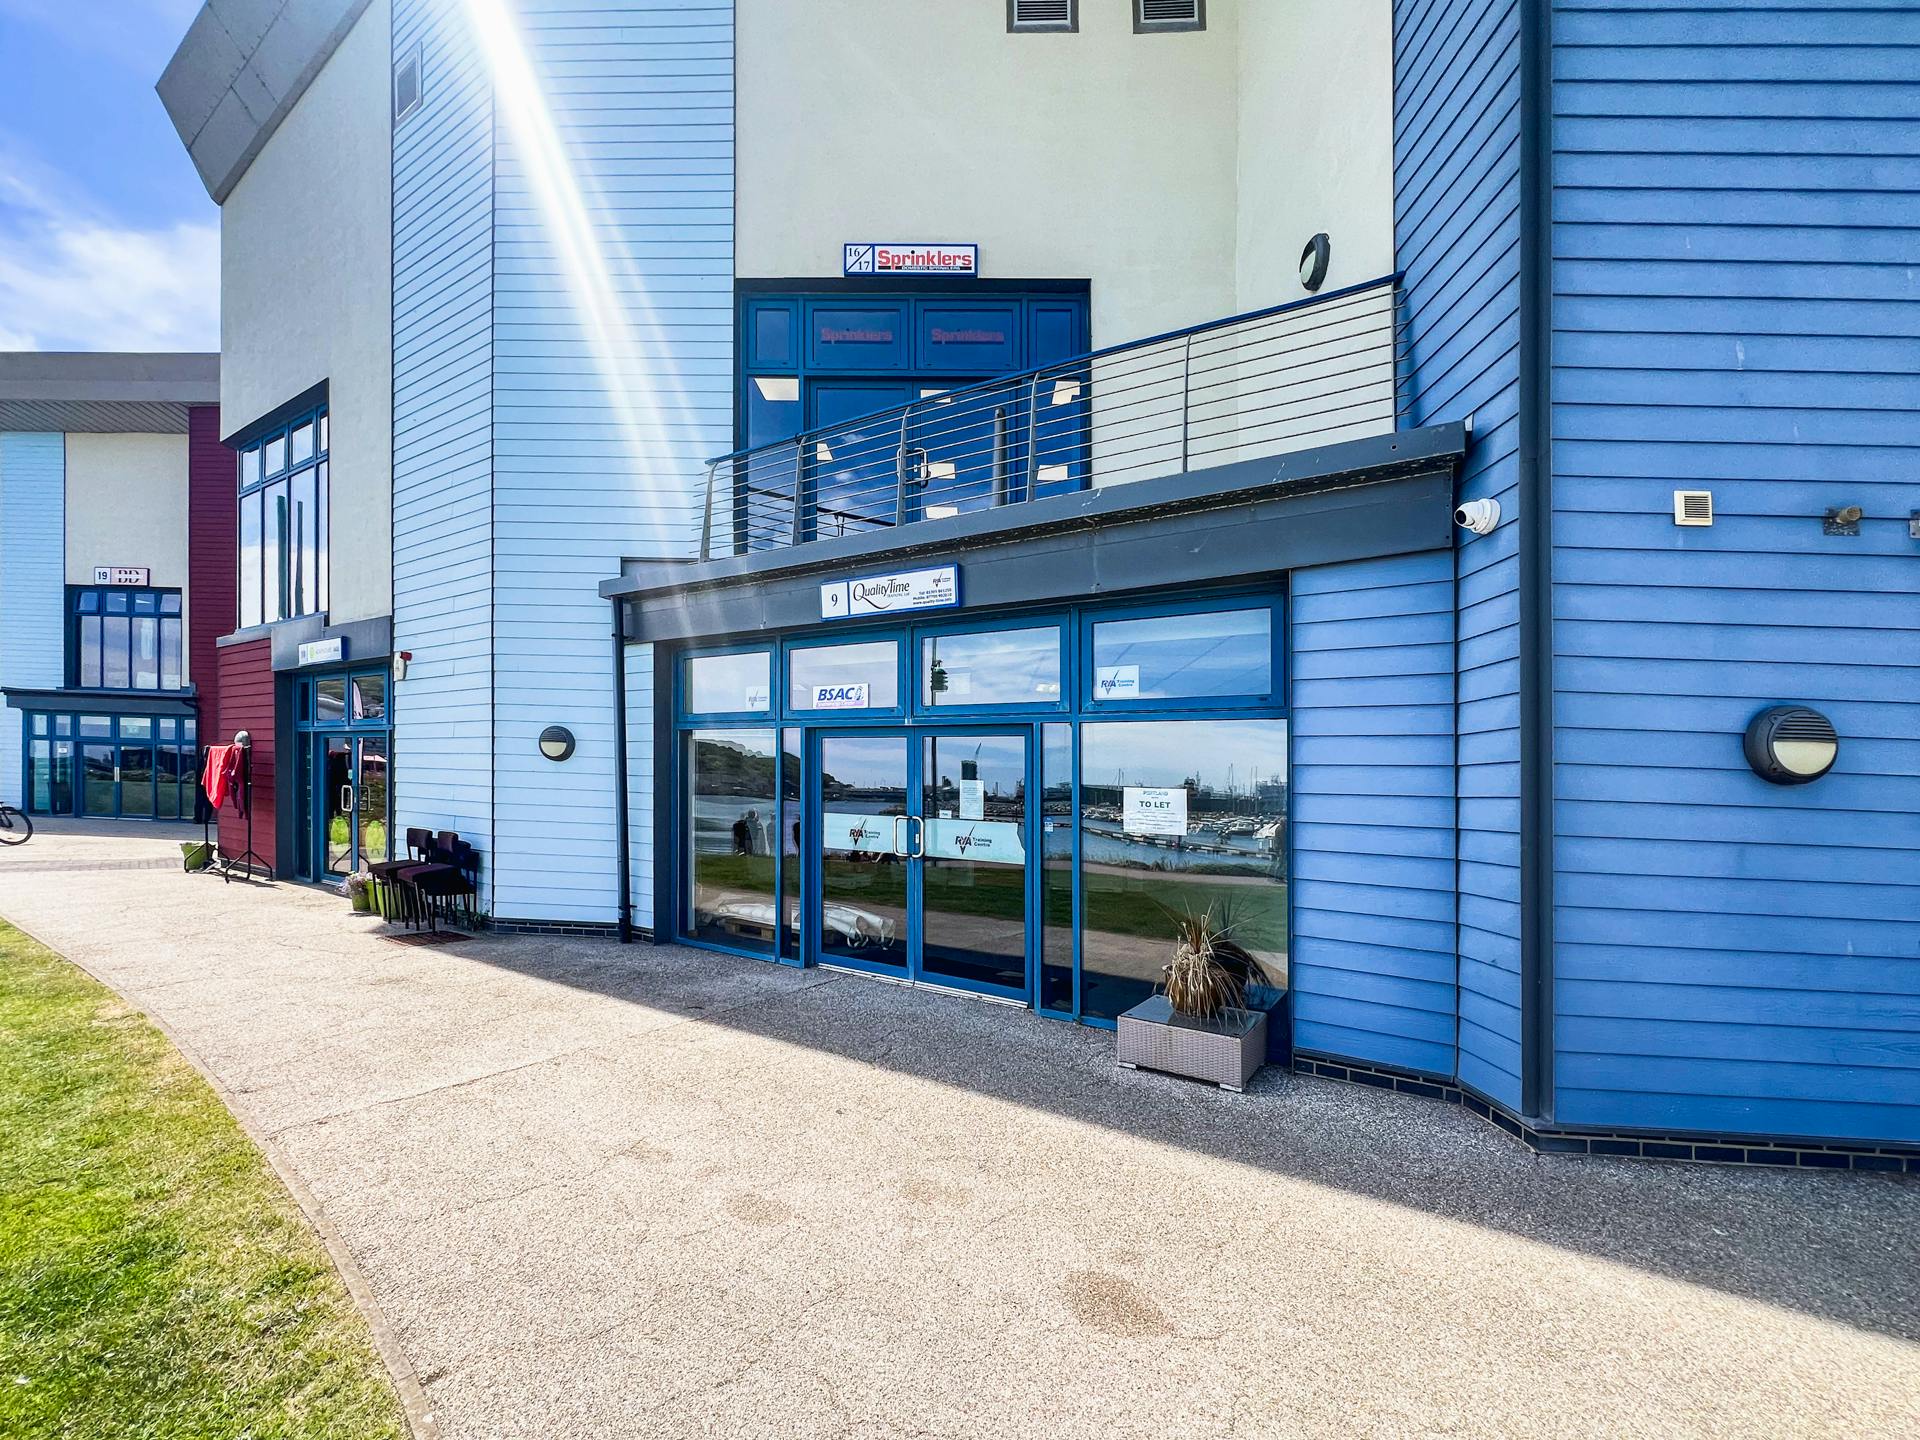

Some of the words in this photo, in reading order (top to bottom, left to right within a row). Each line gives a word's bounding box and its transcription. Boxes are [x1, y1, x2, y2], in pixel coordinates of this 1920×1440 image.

[848, 247, 860, 257] 16
[878, 249, 972, 270] Sprinklers
[859, 261, 870, 271] 17
[98, 571, 107, 580] 19
[831, 593, 838, 607] 9
[818, 687, 854, 701] BSAC
[1154, 801, 1171, 809] LET
